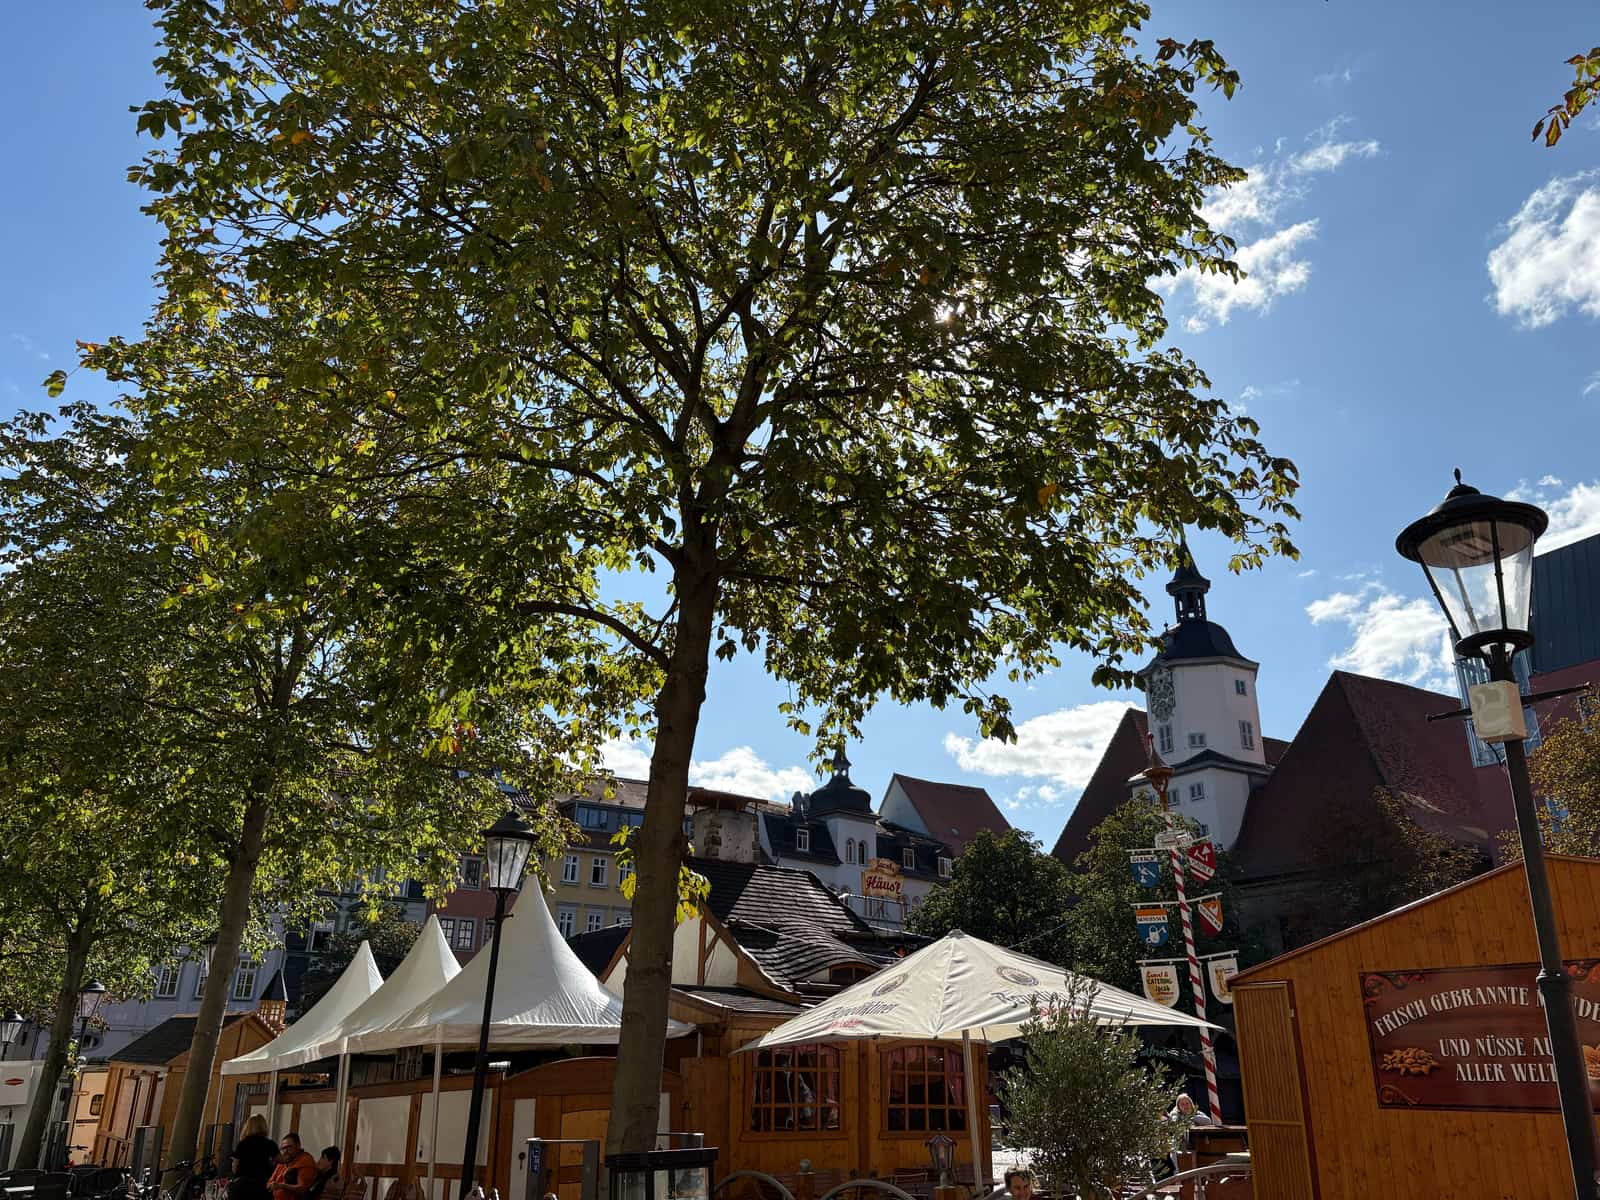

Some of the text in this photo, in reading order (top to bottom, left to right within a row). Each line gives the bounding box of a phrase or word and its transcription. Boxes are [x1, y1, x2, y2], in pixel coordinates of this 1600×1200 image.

[1375, 999, 1429, 1036] FRISCH
[1430, 986, 1529, 1012] GEBRANNTE
[1439, 1038, 1471, 1057] UND
[1475, 1035, 1525, 1057] NÜSSE
[1456, 1063, 1507, 1082] ALLER
